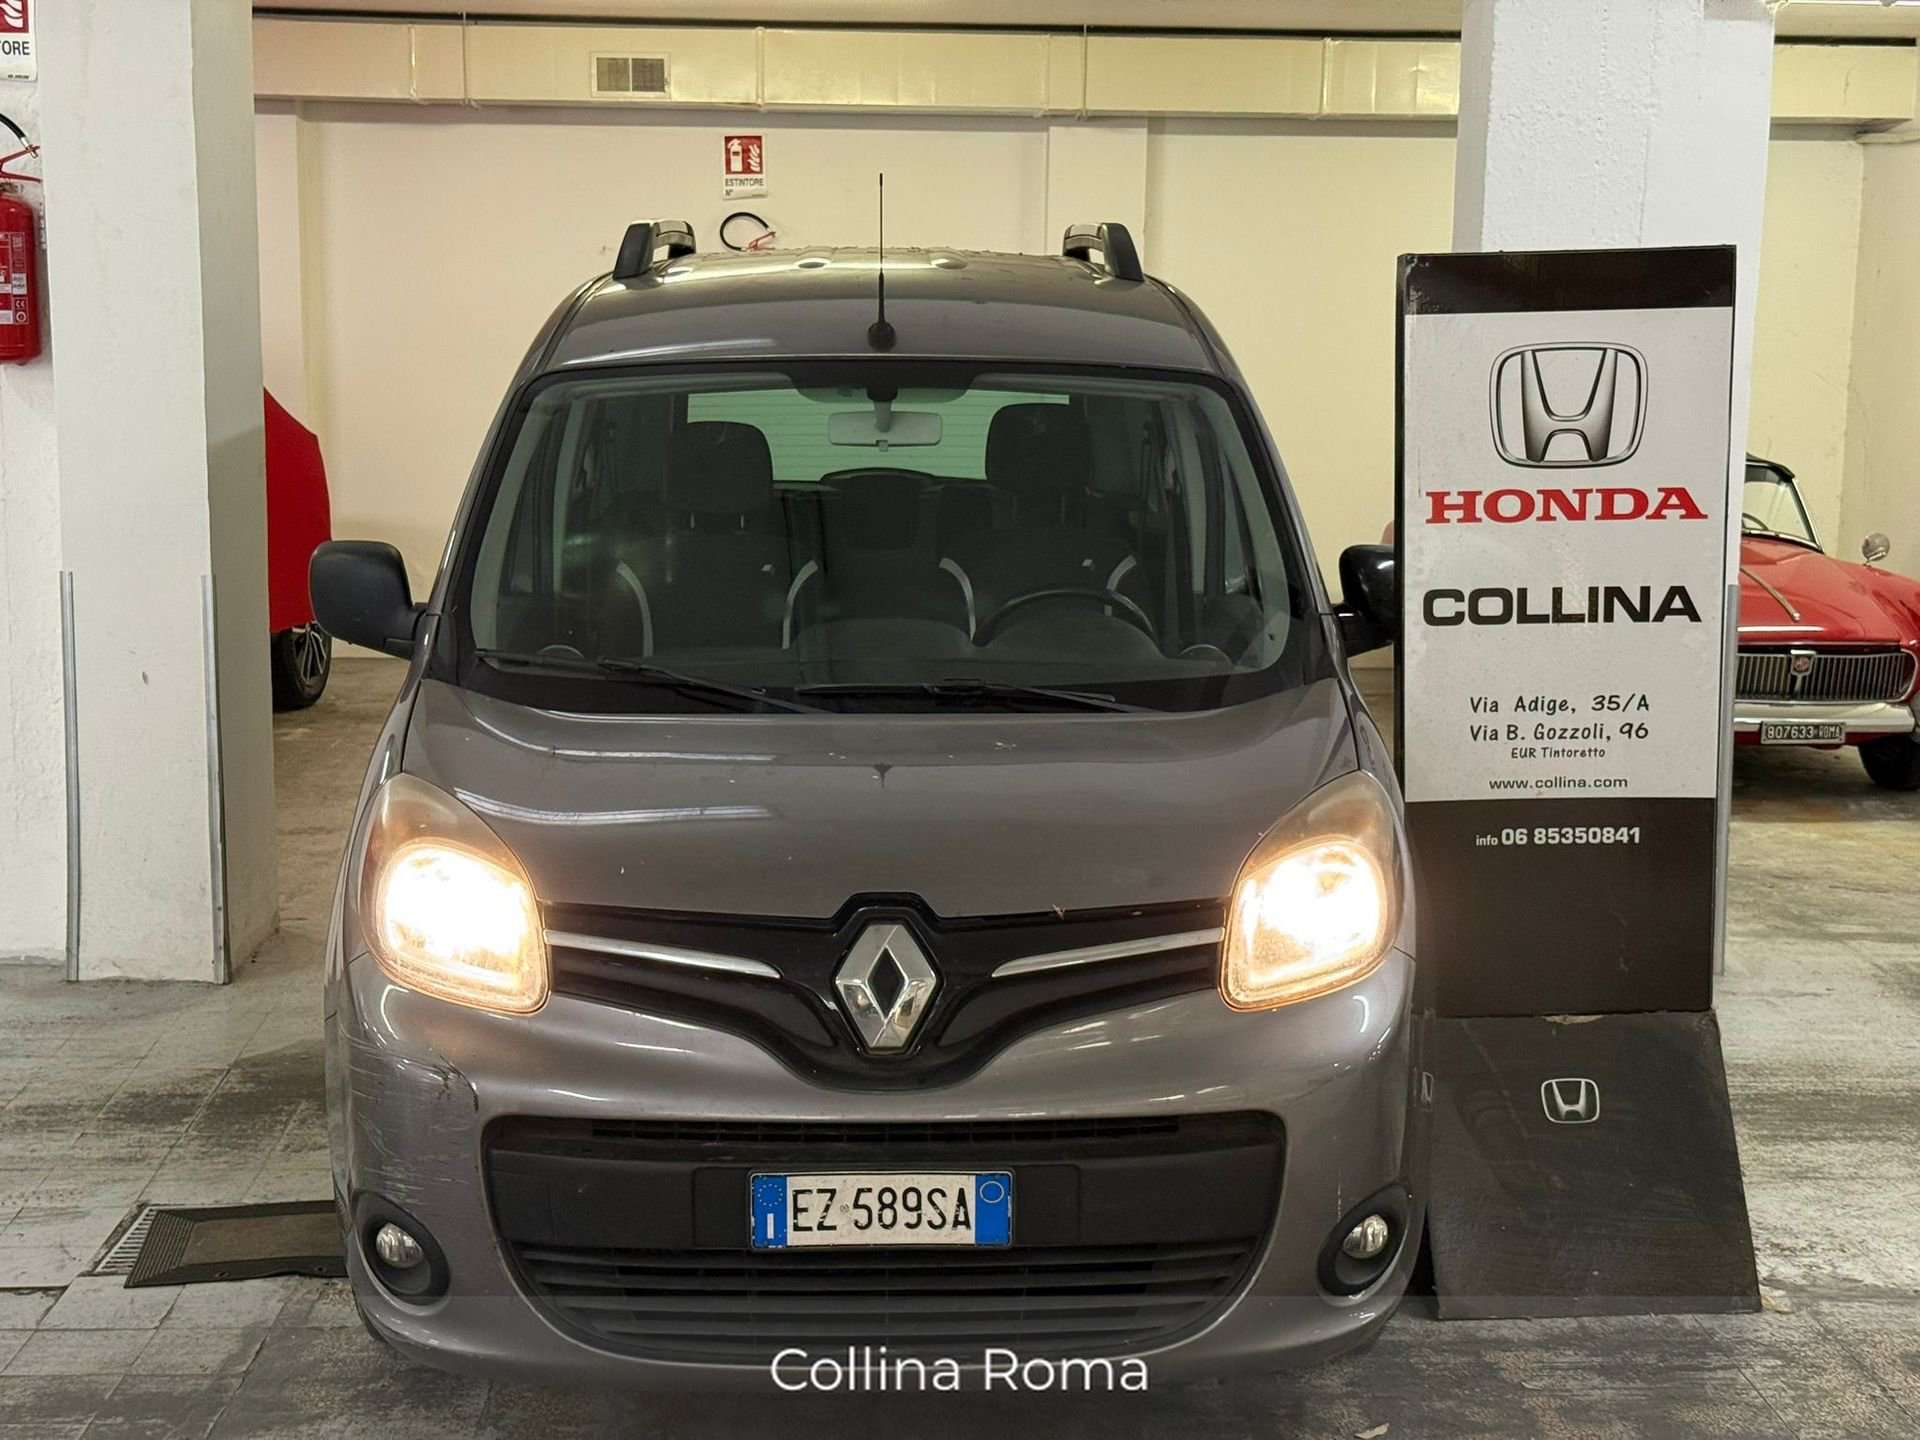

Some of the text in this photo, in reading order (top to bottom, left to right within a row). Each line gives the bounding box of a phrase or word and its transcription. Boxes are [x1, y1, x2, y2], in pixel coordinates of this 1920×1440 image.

[0, 40, 31, 55] ORE
[724, 178, 764, 187] ESTINTORE
[1425, 487, 1708, 524] HONDA
[1423, 585, 1702, 626] COLLINA
[1469, 693, 1650, 715] Via Adige, 35/A
[1469, 722, 1649, 742] Via B. Gozzoli, 96
[1767, 725, 1815, 739] 807633
[1511, 746, 1606, 759] EUR Tintoretto
[1489, 775, 1628, 789] www.collina.com
[1475, 827, 1641, 846] info 06 85350841
[792, 1187, 972, 1232] EZ 589SA
